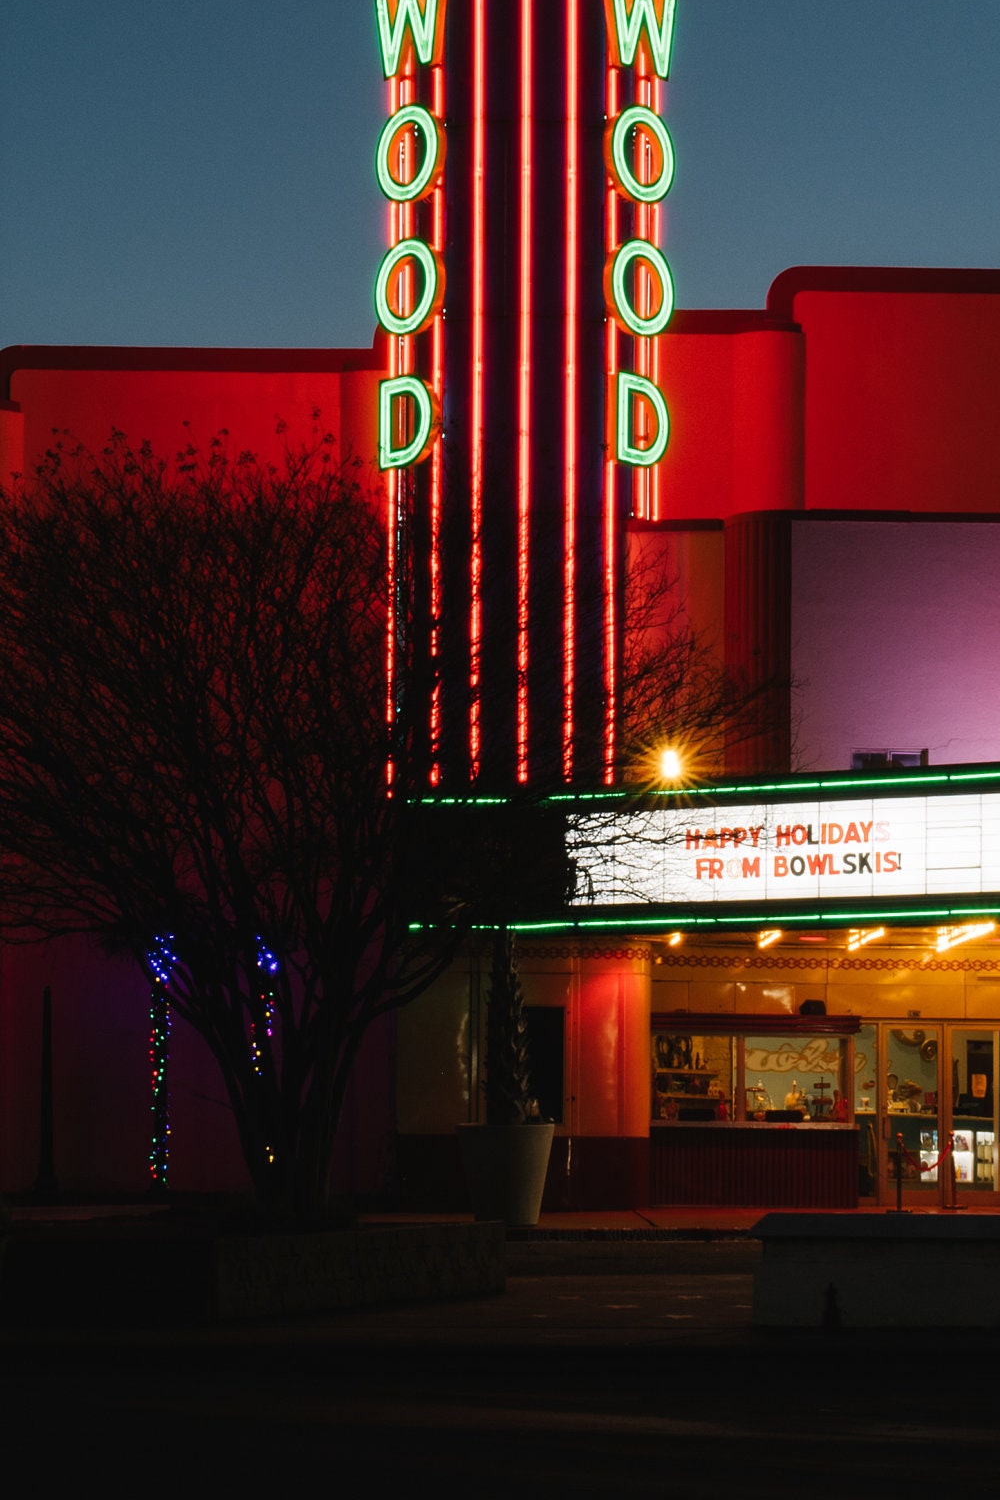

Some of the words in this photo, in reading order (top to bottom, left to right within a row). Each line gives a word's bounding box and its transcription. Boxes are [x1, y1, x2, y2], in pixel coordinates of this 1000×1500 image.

[685, 825, 763, 850] HAPPY
[695, 856, 760, 880] FROM
[773, 851, 903, 877] BOWLSKIS!
